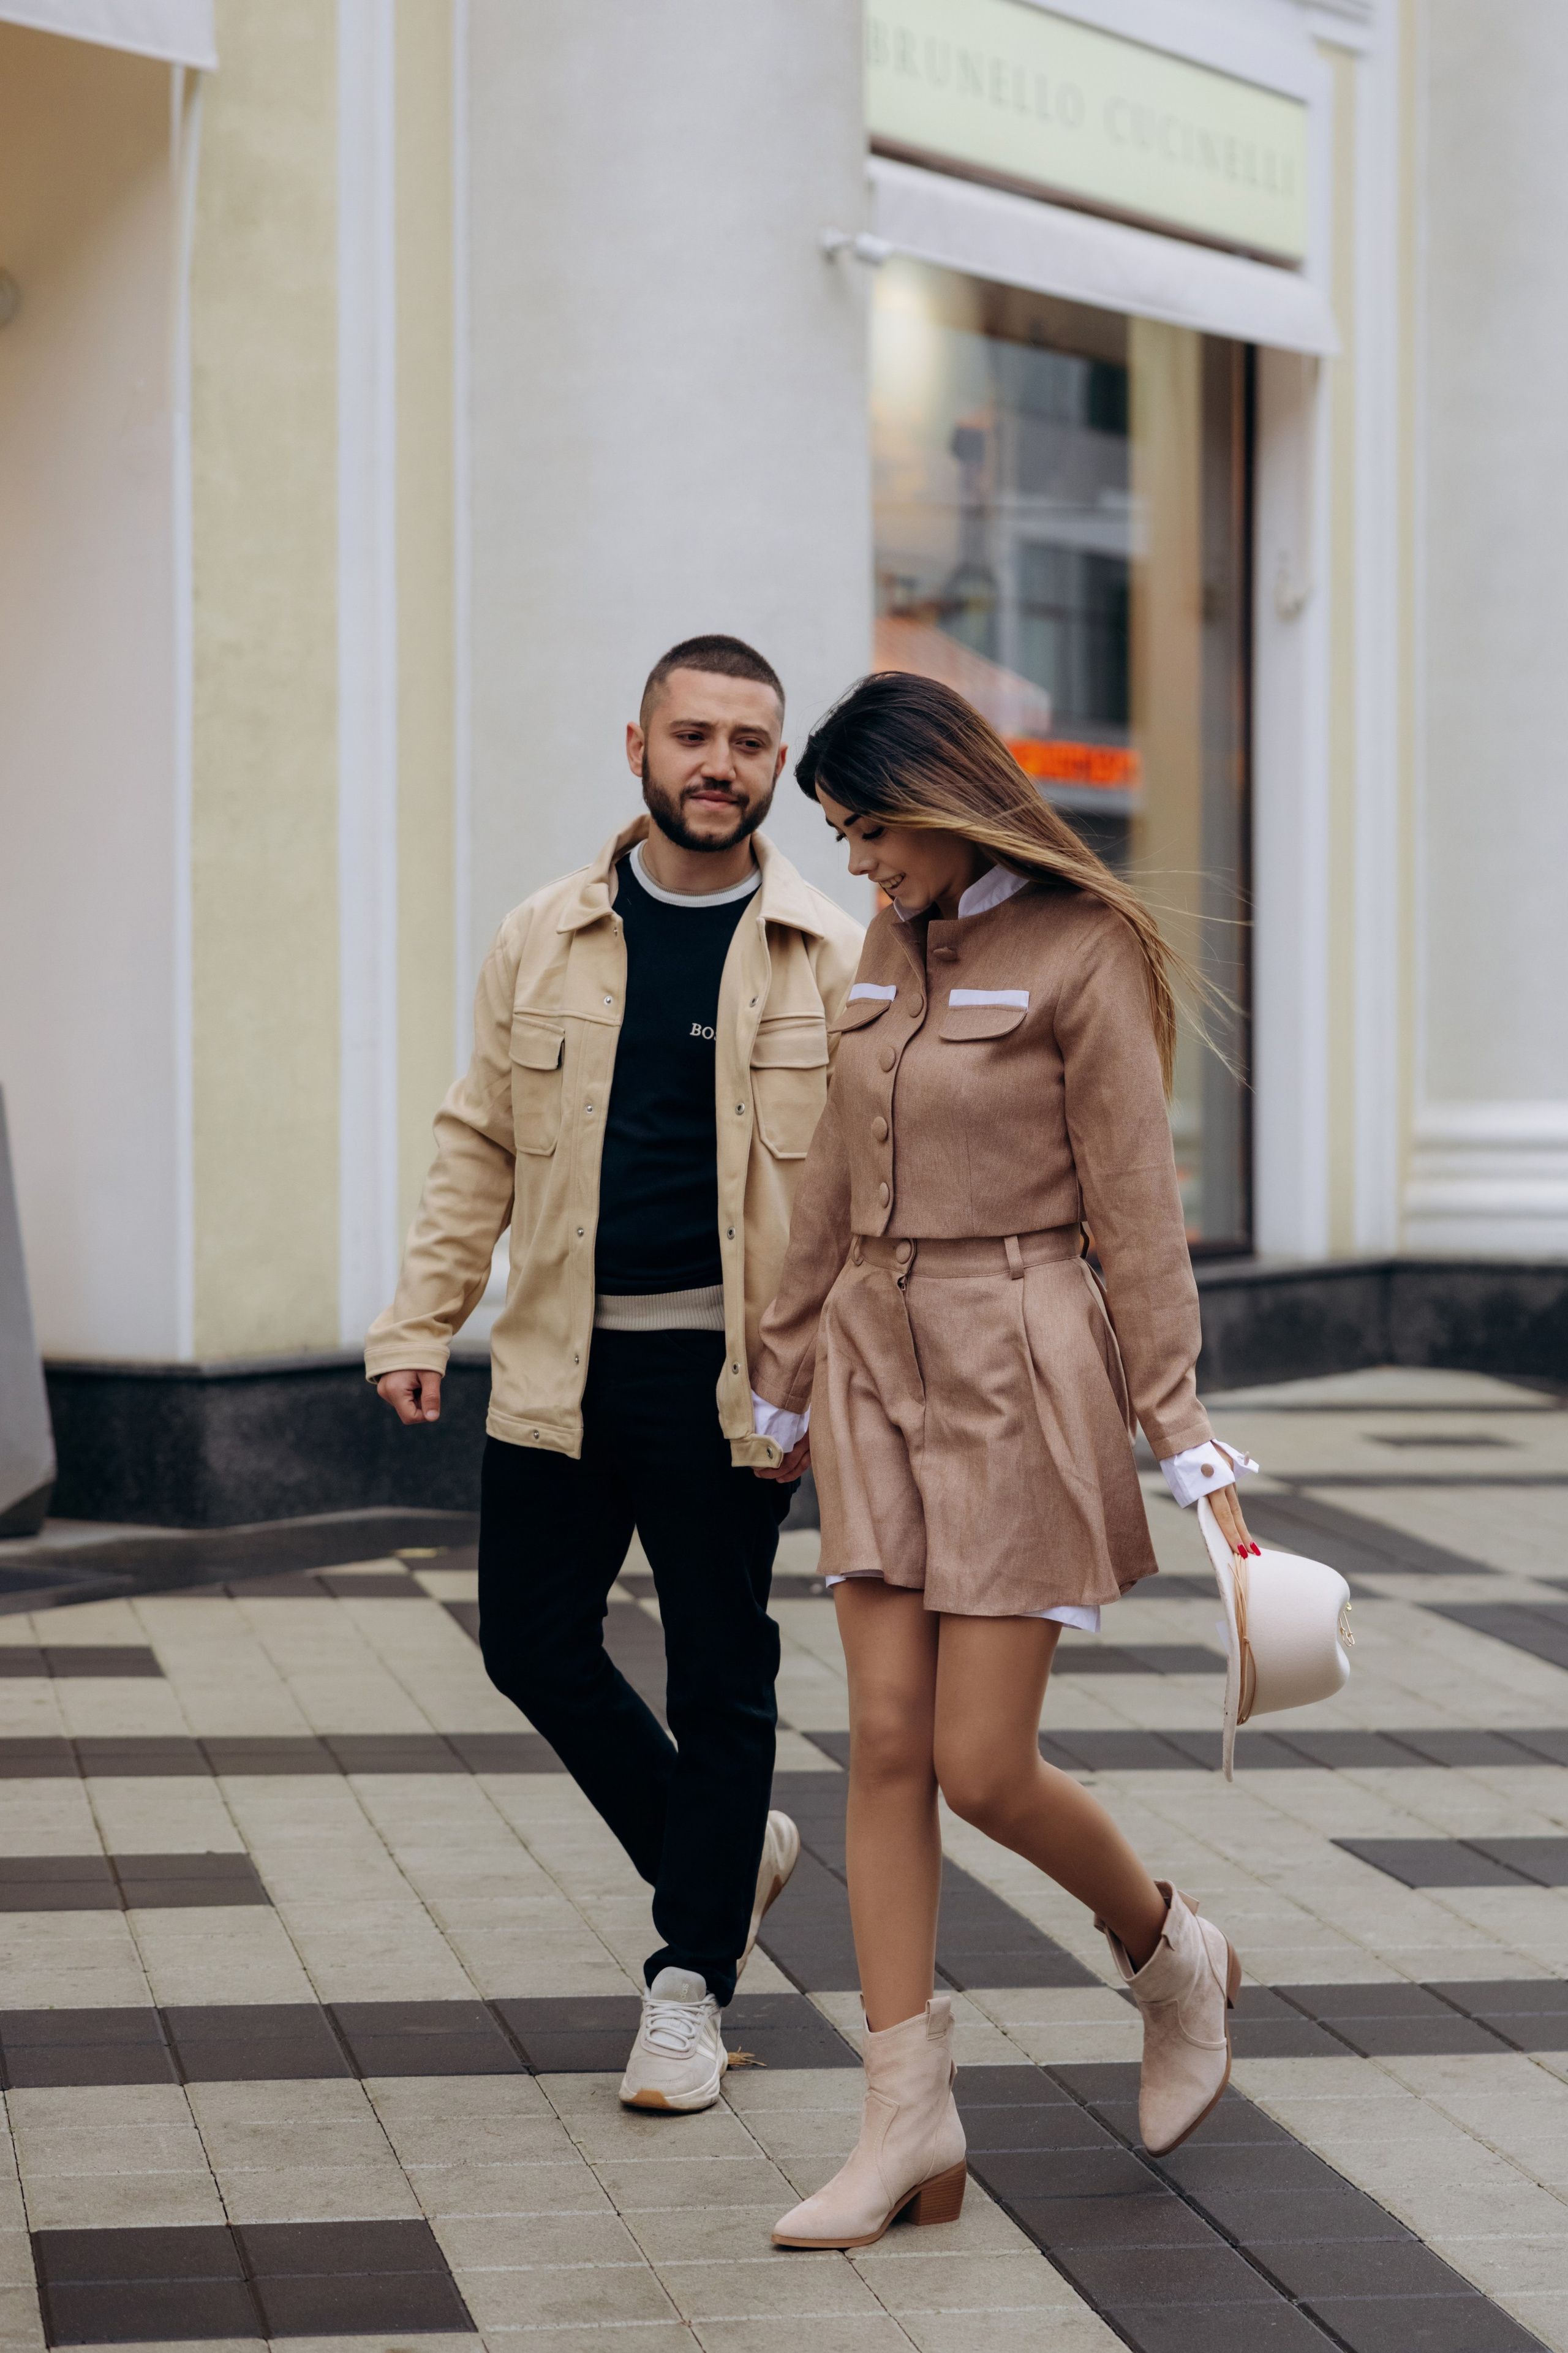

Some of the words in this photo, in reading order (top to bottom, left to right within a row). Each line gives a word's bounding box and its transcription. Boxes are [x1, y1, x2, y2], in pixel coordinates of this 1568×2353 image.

[865, 17, 1086, 130] BRUNELLO
[1101, 94, 1297, 200] CUCINELLI
[689, 1022, 717, 1041] BO
[679, 1983, 689, 2001] das
